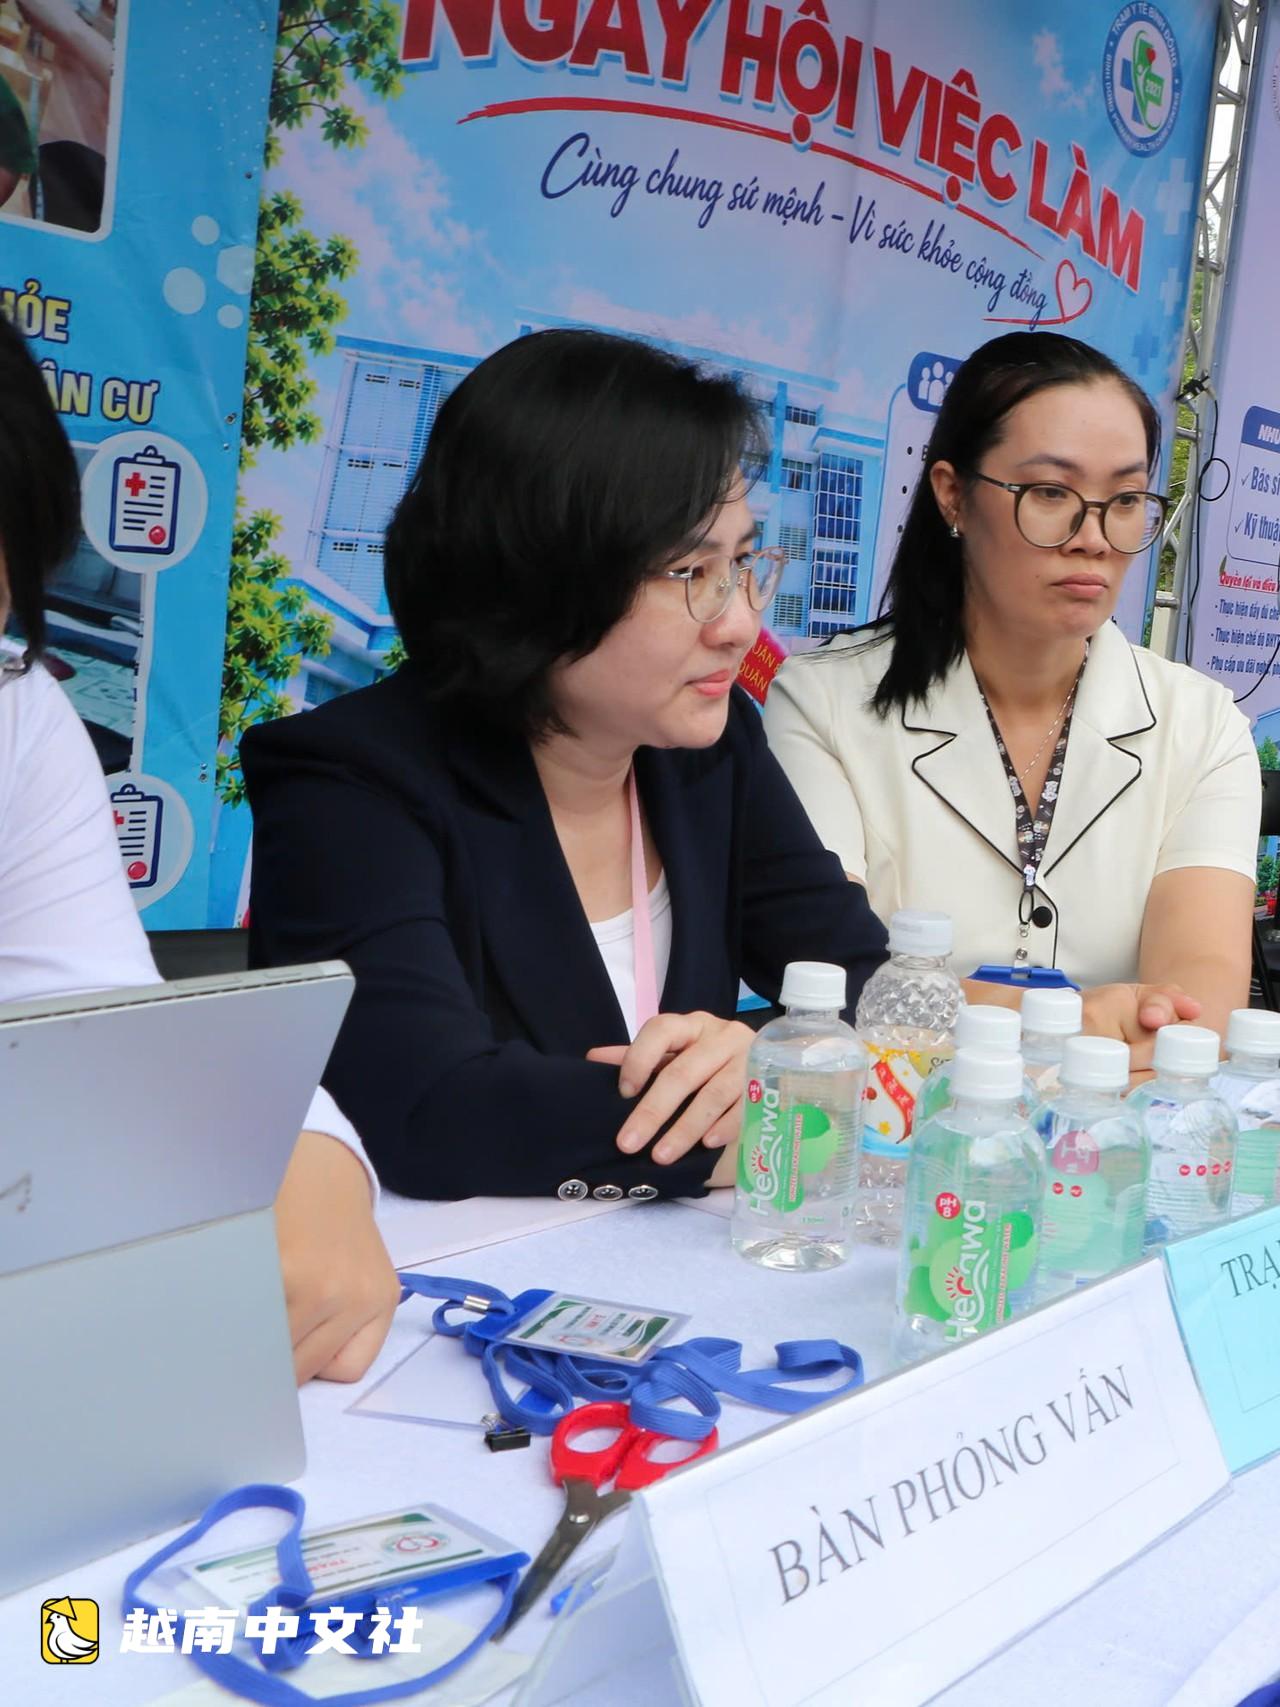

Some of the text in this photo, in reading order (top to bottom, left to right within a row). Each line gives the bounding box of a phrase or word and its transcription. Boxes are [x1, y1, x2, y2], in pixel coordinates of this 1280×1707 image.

[720, 0, 864, 144] HỘI
[873, 46, 1023, 204] VIỆC
[1027, 138, 1145, 293] LÀM
[540, 132, 640, 219] Cùng
[645, 148, 725, 229] chung
[727, 176, 760, 211] sứ
[762, 180, 825, 227] mệnh
[849, 195, 876, 244] Vì
[878, 219, 915, 254] sức
[917, 219, 963, 274] khỏe
[966, 256, 1007, 313] cộng
[1010, 268, 1048, 331] đồng
[101, 376, 160, 425] CƯ
[1243, 511, 1258, 540] Kỹ
[939, 1197, 957, 1208] pH
[942, 1206, 952, 1218] 8
[768, 1364, 1135, 1606] BÀN PHỎNG VẤN
